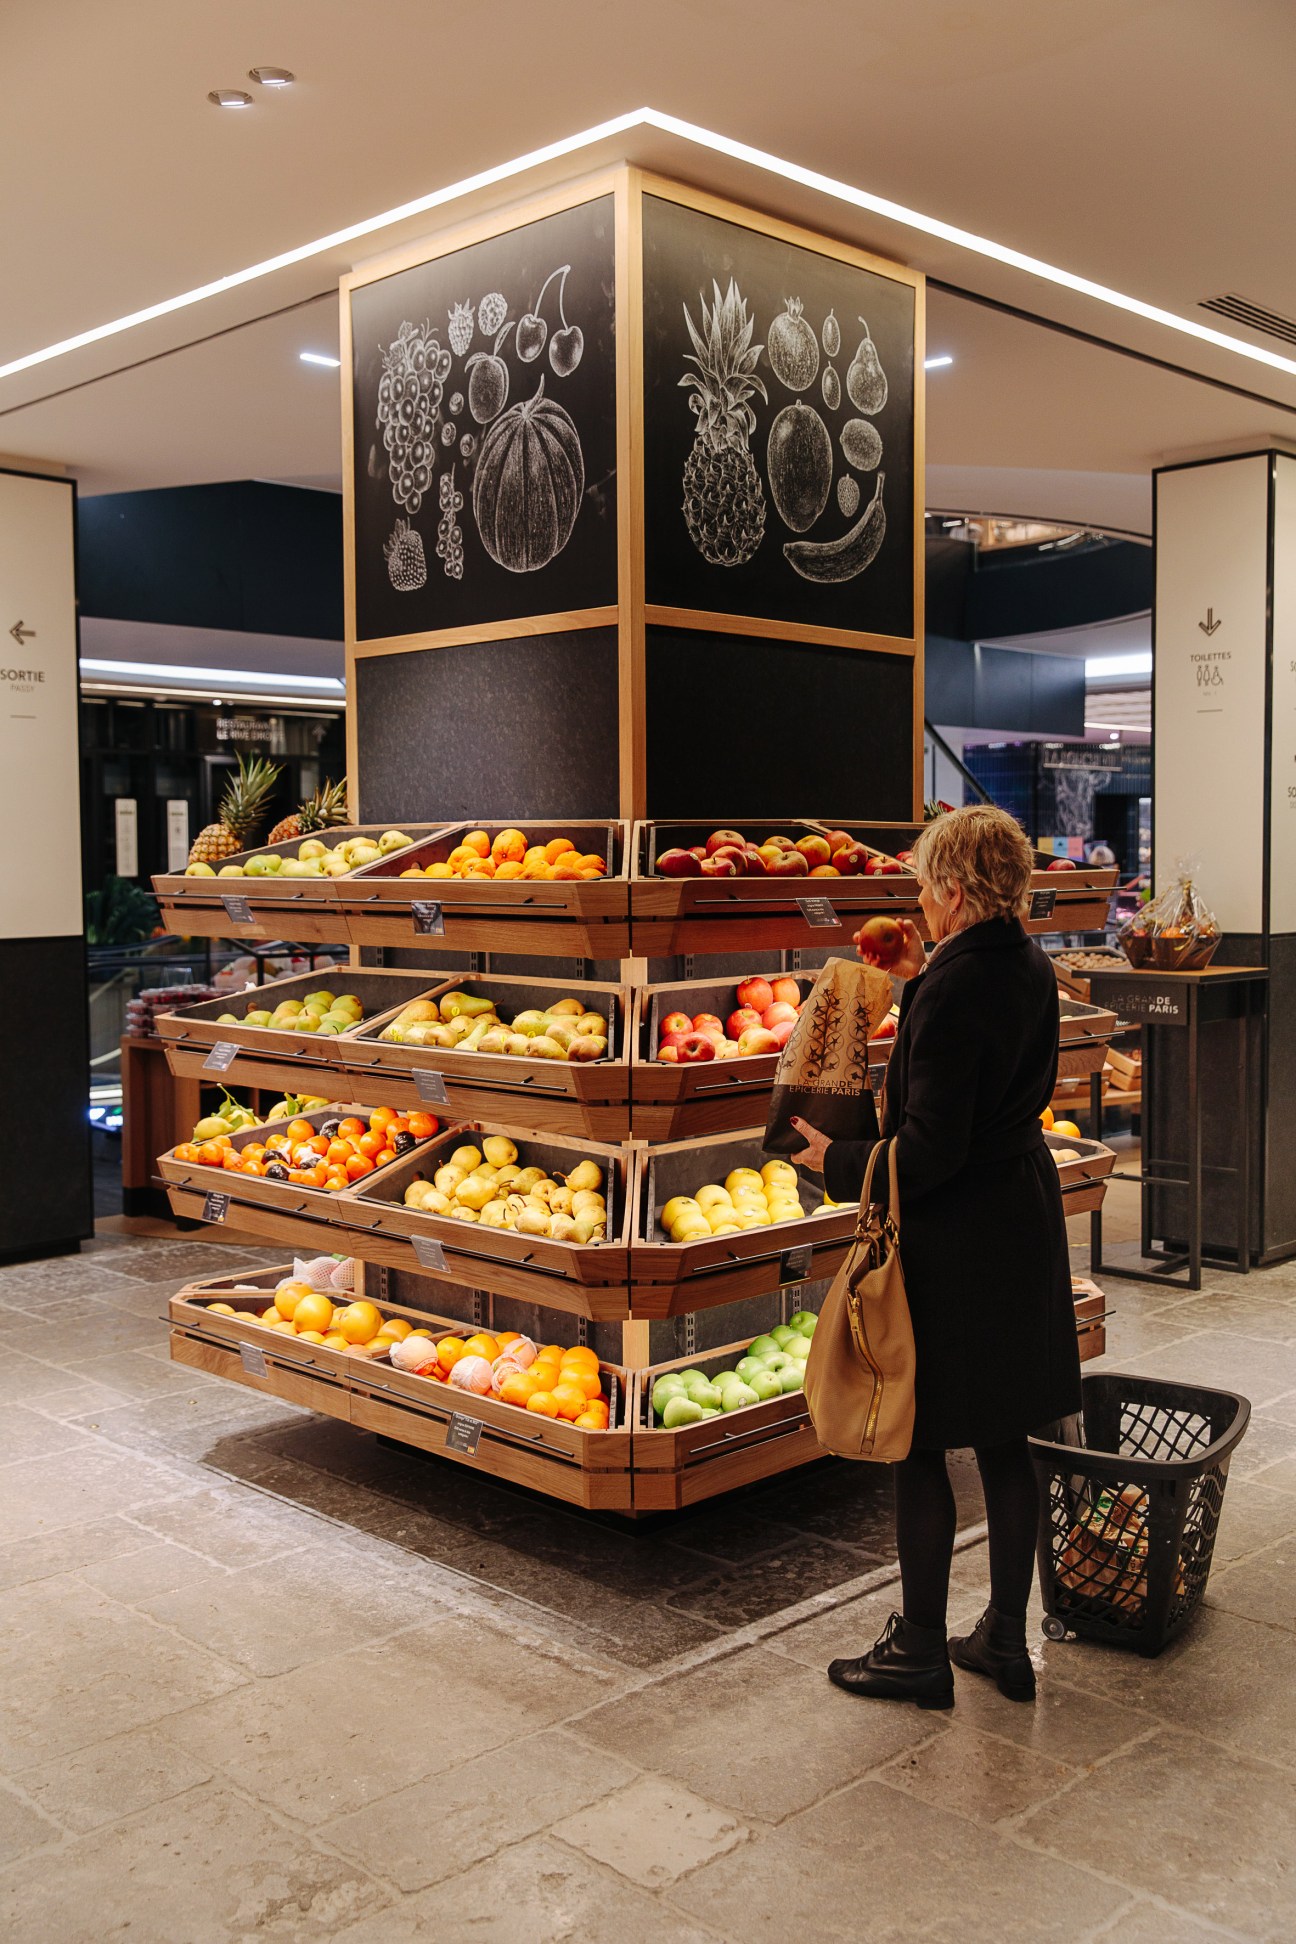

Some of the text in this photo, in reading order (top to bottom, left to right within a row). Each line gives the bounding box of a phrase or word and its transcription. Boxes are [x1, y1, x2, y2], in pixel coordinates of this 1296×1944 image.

[1190, 651, 1232, 662] TOILETTES
[0, 669, 46, 682] SORTIE
[1112, 994, 1171, 1005] LA GRANDE
[1148, 1004, 1179, 1014] PARIS
[797, 1079, 853, 1088] LA GRANDE
[789, 1086, 861, 1096] EPICERIE PARIS
